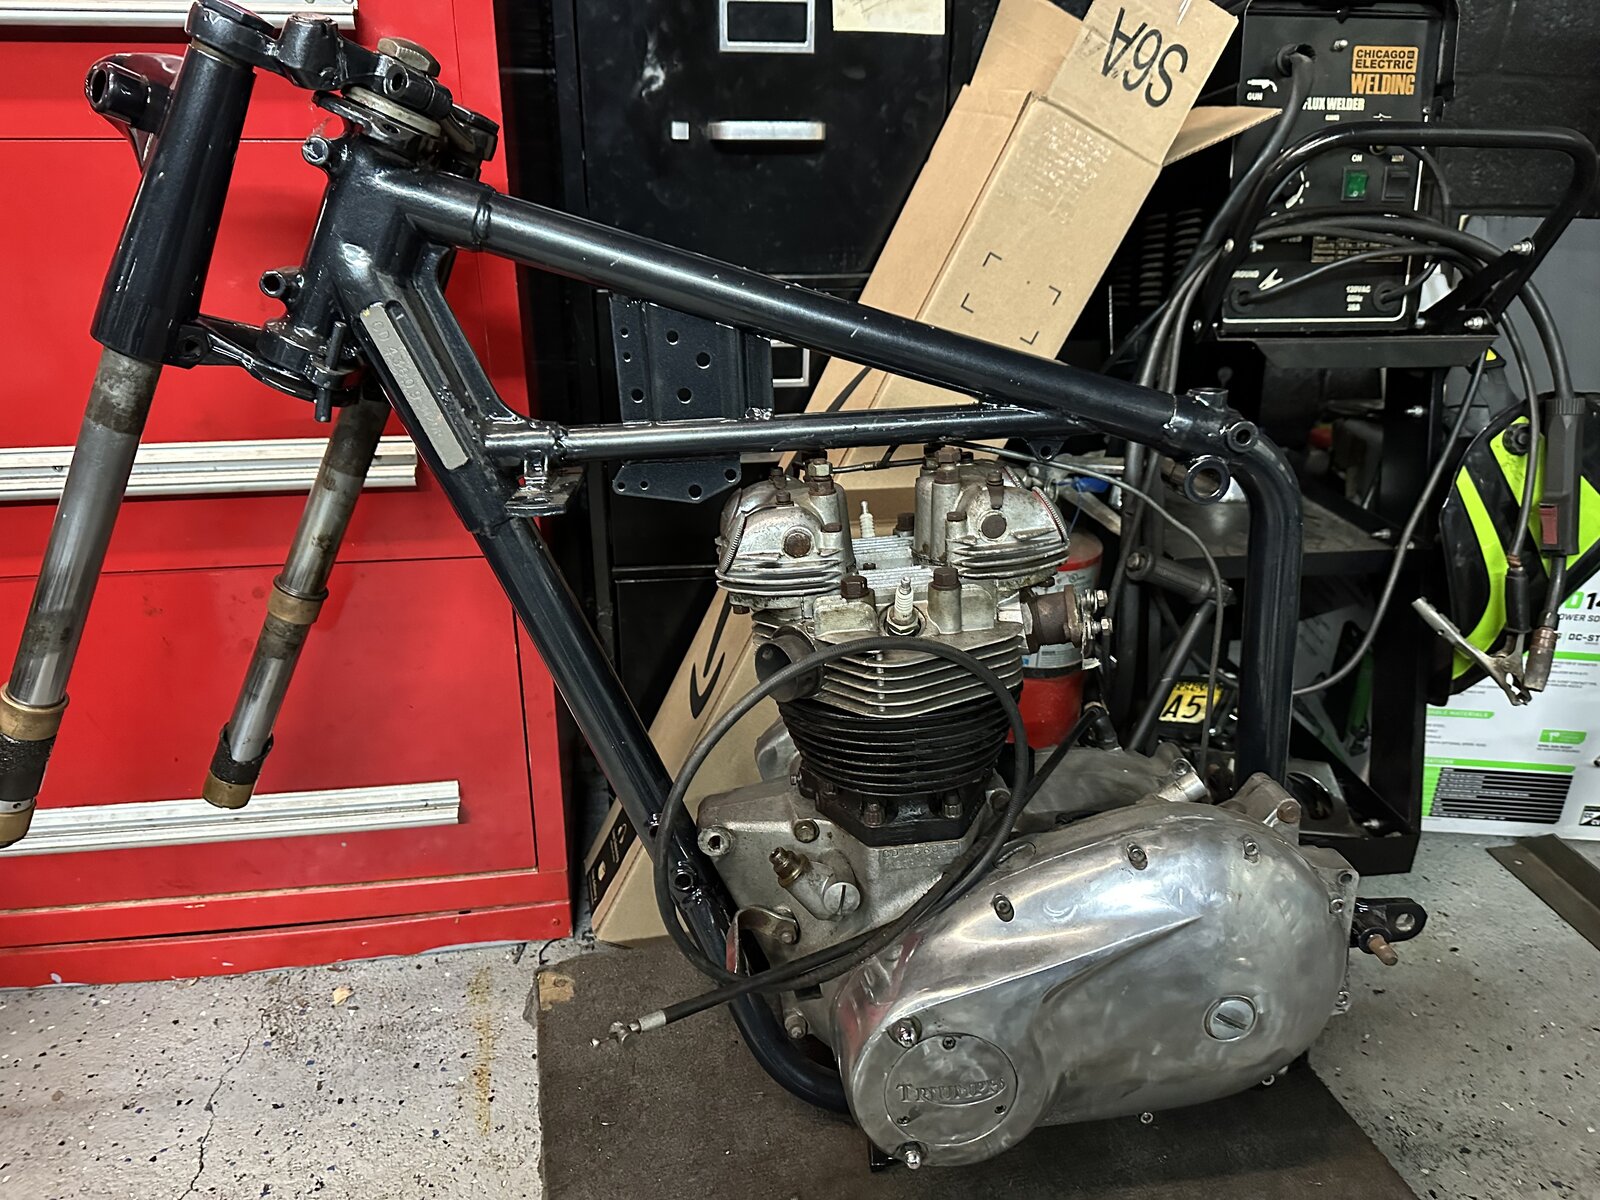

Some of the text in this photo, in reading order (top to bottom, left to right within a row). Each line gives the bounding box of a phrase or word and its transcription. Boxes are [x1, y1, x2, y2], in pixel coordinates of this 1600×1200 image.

[1101, 7, 1188, 107] S6A
[1356, 49, 1406, 59] CHICAGO
[1355, 59, 1413, 69] ELECTRIC
[1351, 73, 1416, 95] WELDING
[1247, 92, 1263, 101] GUN
[1326, 98, 1365, 111] WELDER
[1351, 154, 1362, 162] ON
